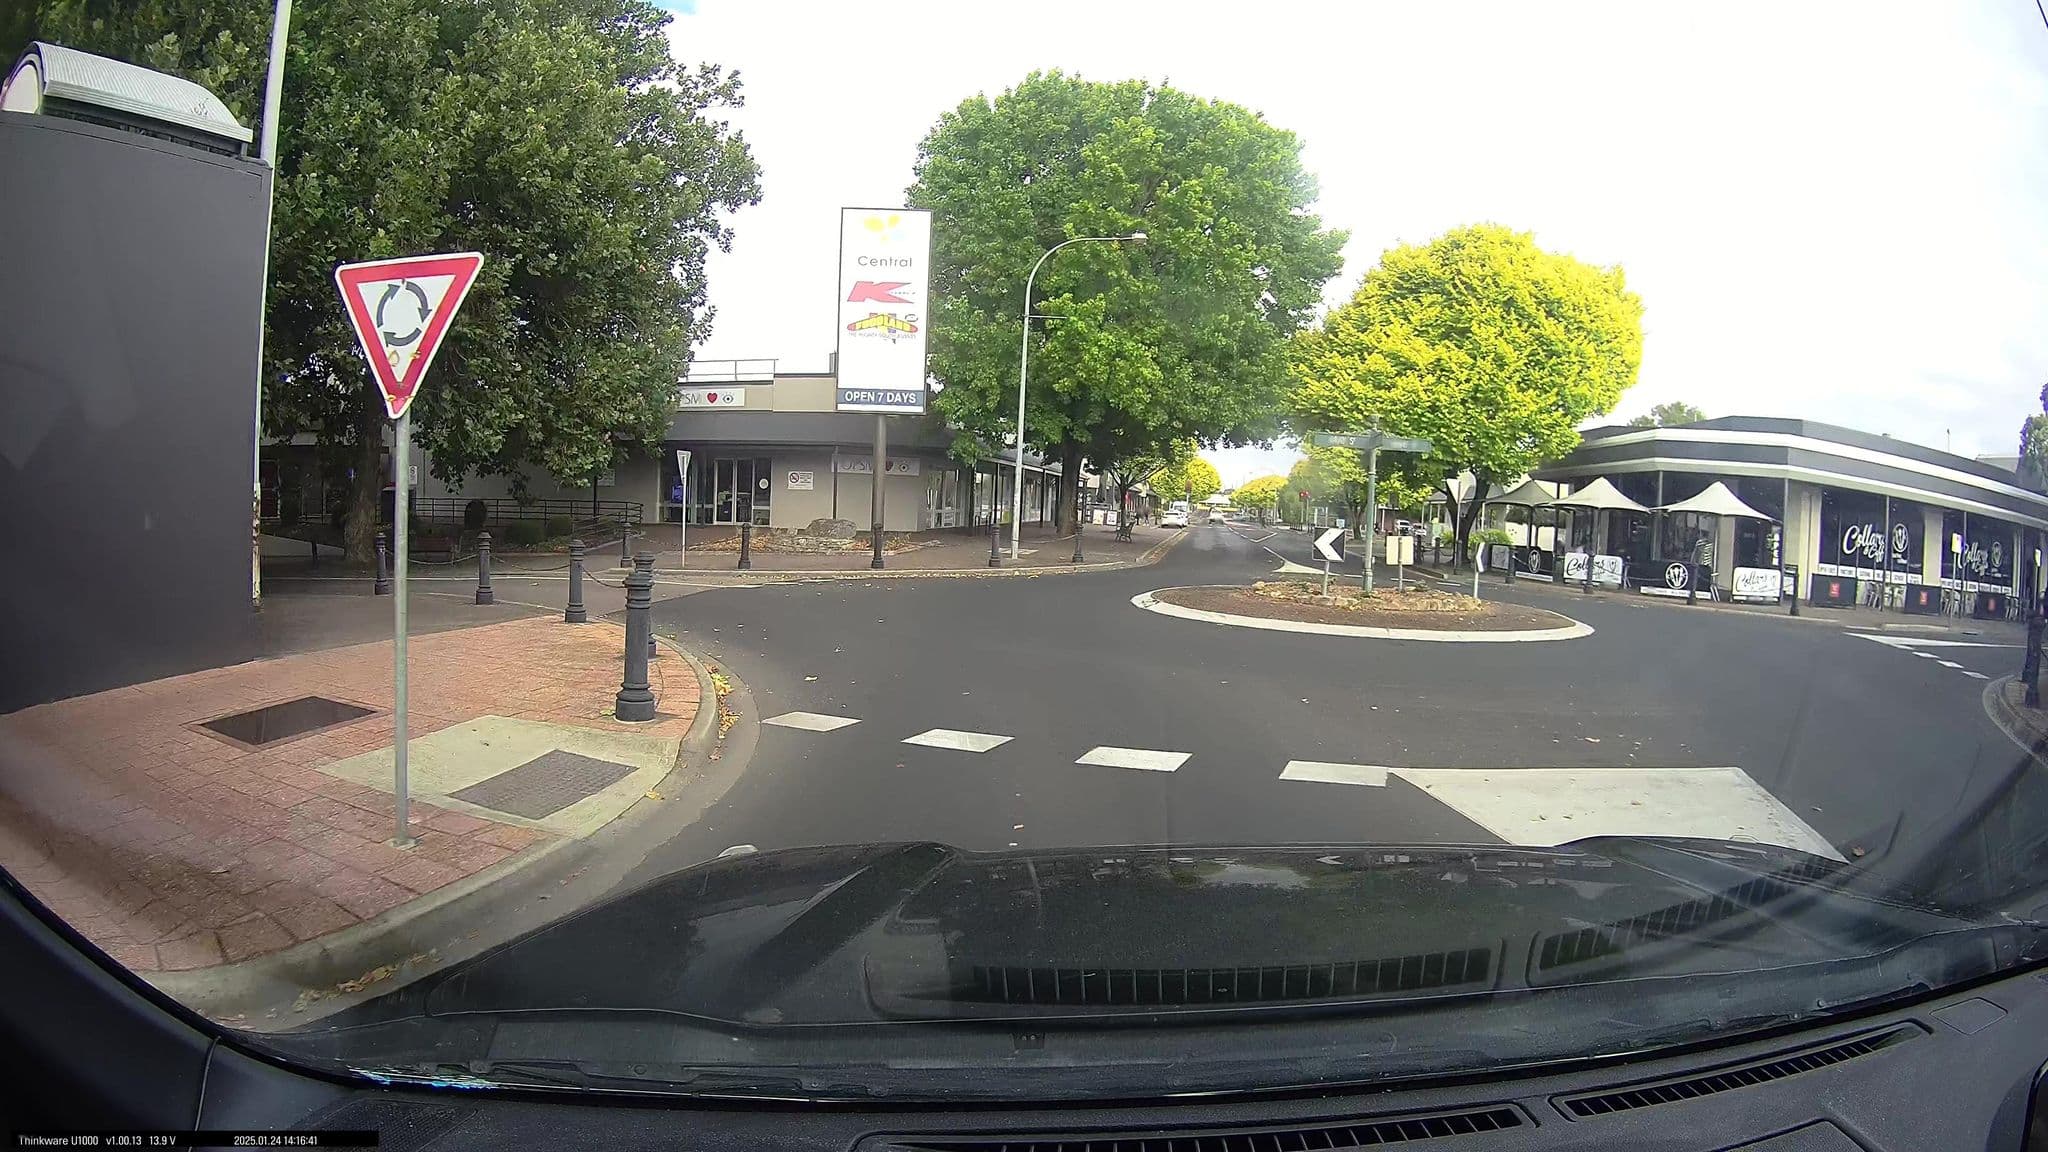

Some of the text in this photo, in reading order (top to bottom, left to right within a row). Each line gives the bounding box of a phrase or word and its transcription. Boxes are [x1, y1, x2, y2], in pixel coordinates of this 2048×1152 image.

[857, 255, 912, 268] Central
[845, 391, 916, 404] OPEN 7 DAYS
